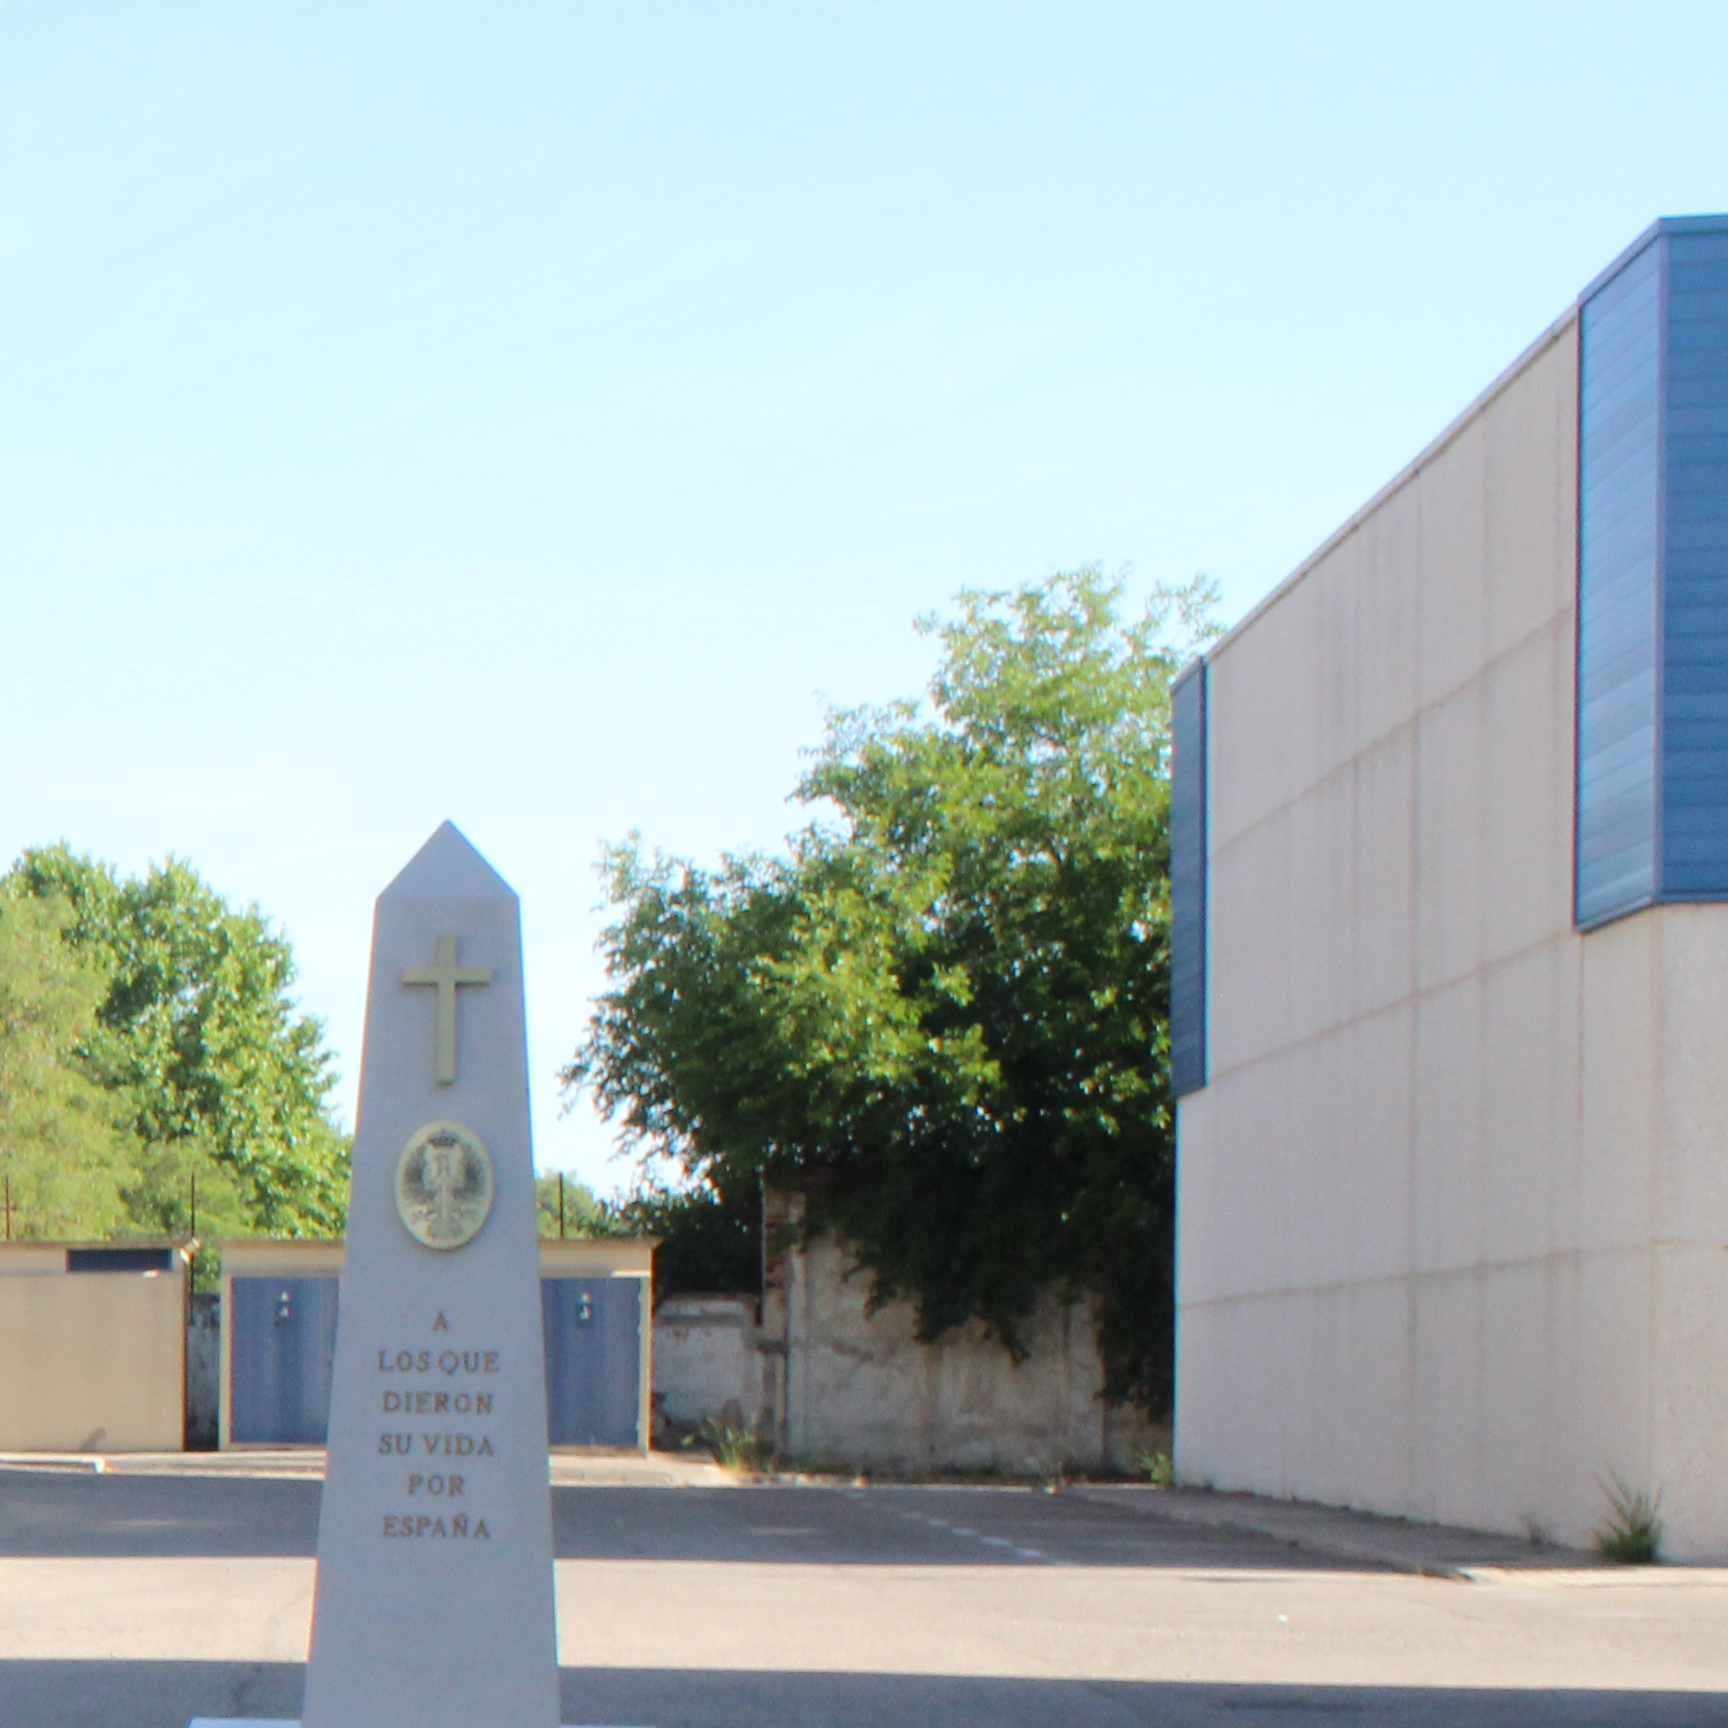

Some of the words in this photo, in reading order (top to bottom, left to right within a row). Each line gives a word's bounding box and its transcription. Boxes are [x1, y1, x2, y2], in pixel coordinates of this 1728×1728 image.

[431, 1311, 449, 1332] A
[377, 1350, 431, 1372] LOS
[438, 1350, 500, 1376] QUE
[382, 1391, 494, 1415] DIERON
[378, 1434, 412, 1456] SU
[423, 1434, 495, 1456] VIDA
[407, 1473, 465, 1496] POR
[382, 1512, 491, 1539] ESPAÑA
